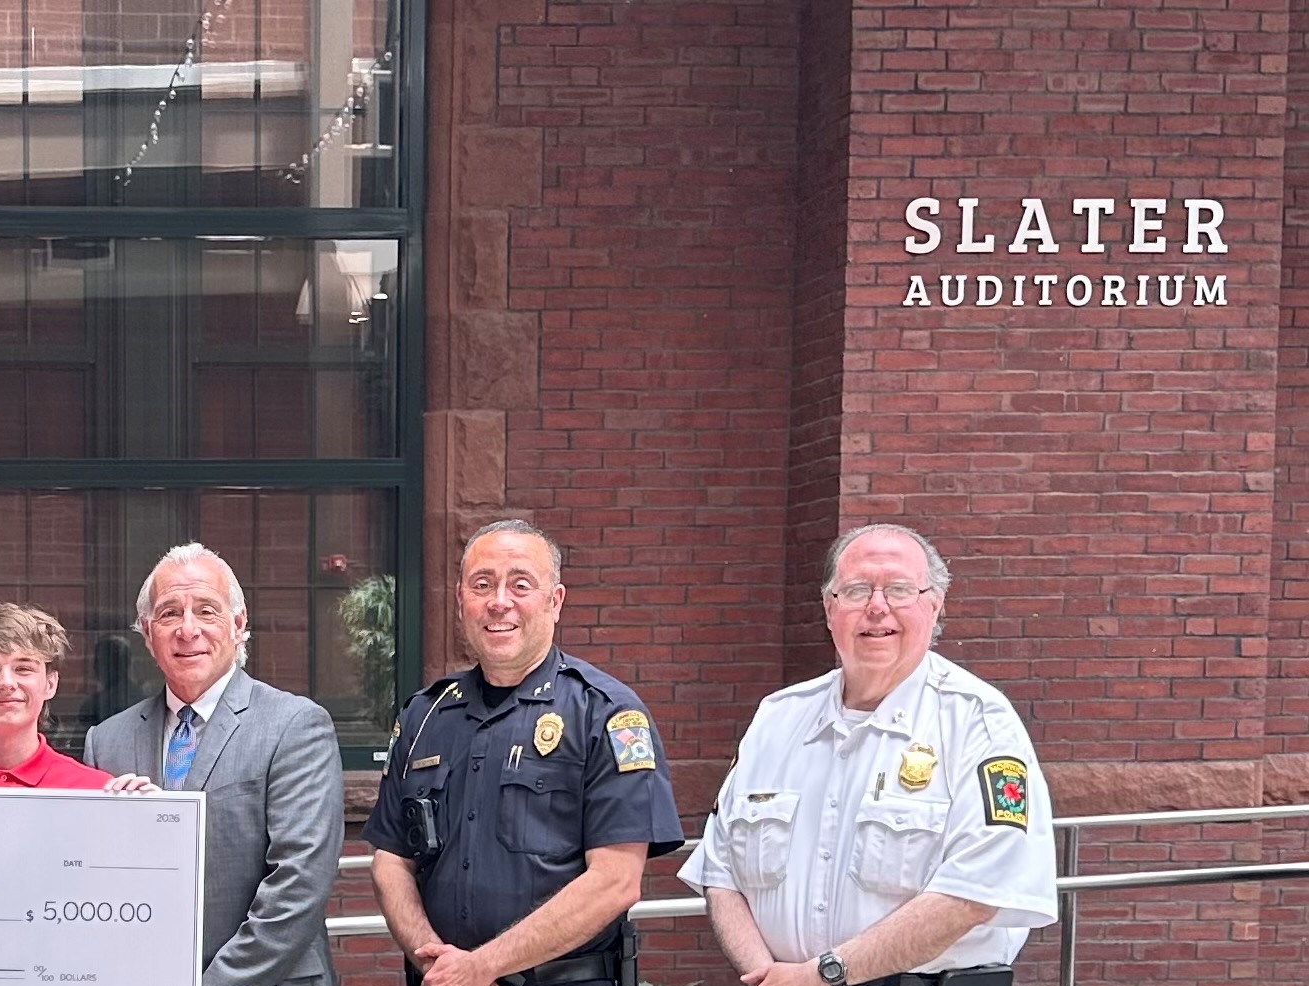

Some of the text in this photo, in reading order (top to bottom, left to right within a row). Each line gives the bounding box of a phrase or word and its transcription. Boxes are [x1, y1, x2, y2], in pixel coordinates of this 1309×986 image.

[904, 197, 1229, 254] SLATER
[902, 275, 1228, 307] AUDITORIUM
[25, 900, 153, 925] $ 5,000.00
[59, 973, 97, 982] DOLLARS
